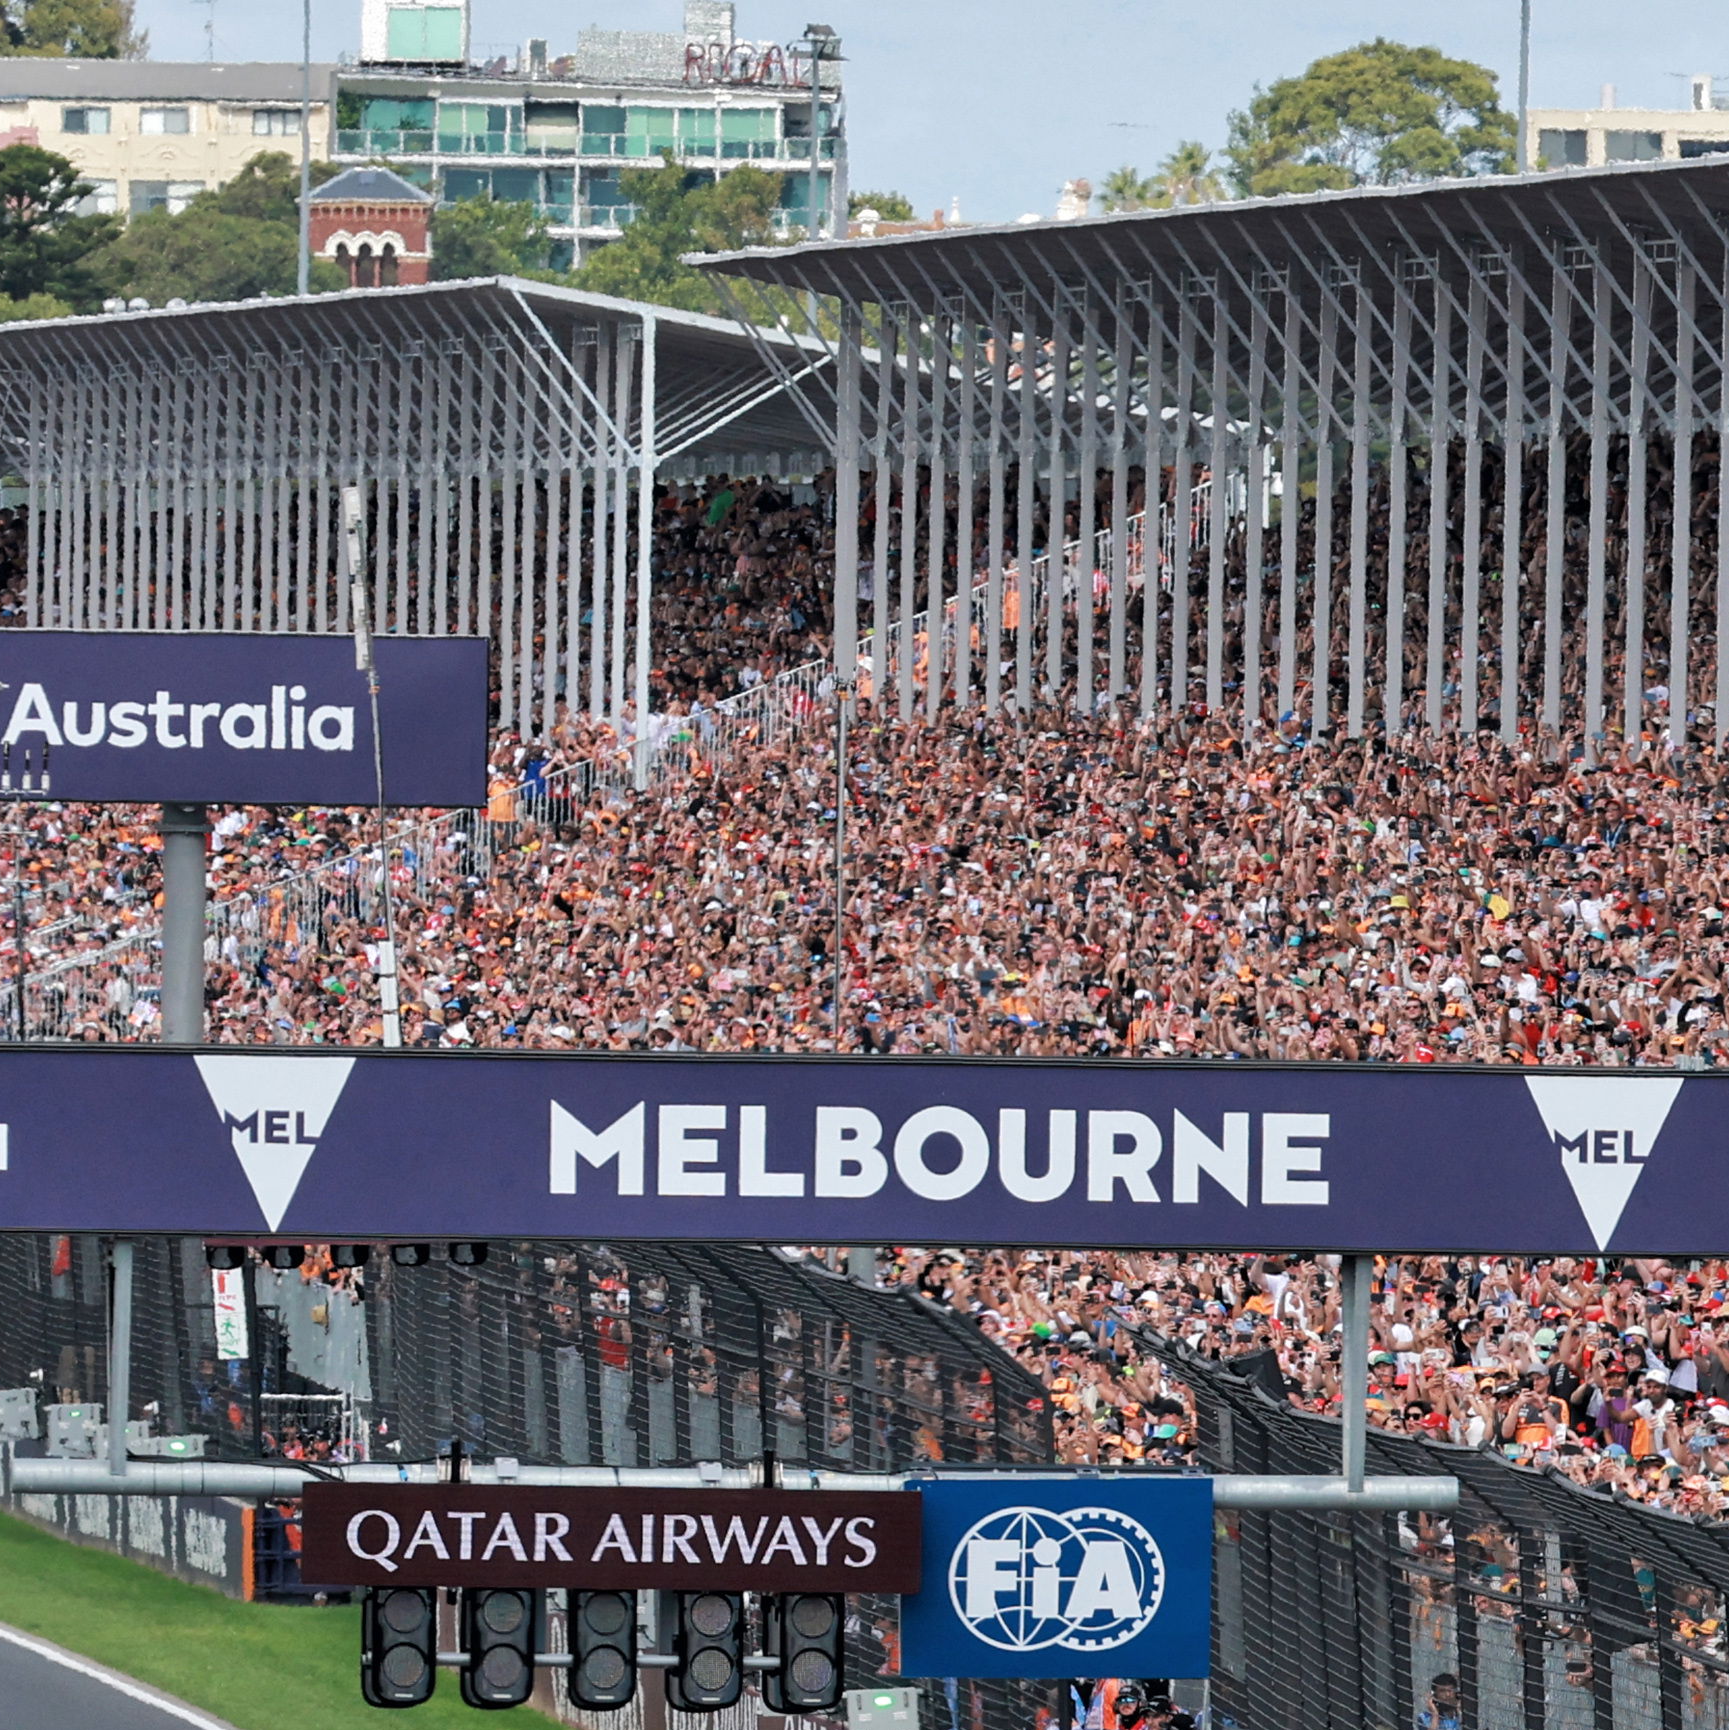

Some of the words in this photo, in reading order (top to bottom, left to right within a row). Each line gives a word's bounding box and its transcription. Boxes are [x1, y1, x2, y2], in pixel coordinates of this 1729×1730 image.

[2, 682, 355, 752] Australia
[223, 1109, 319, 1146] MEL
[549, 1100, 1329, 1207] MELBOURNE
[1553, 1129, 1647, 1165] MEL
[347, 1510, 574, 1571] QATAR
[592, 1513, 876, 1567] AIRWAYS
